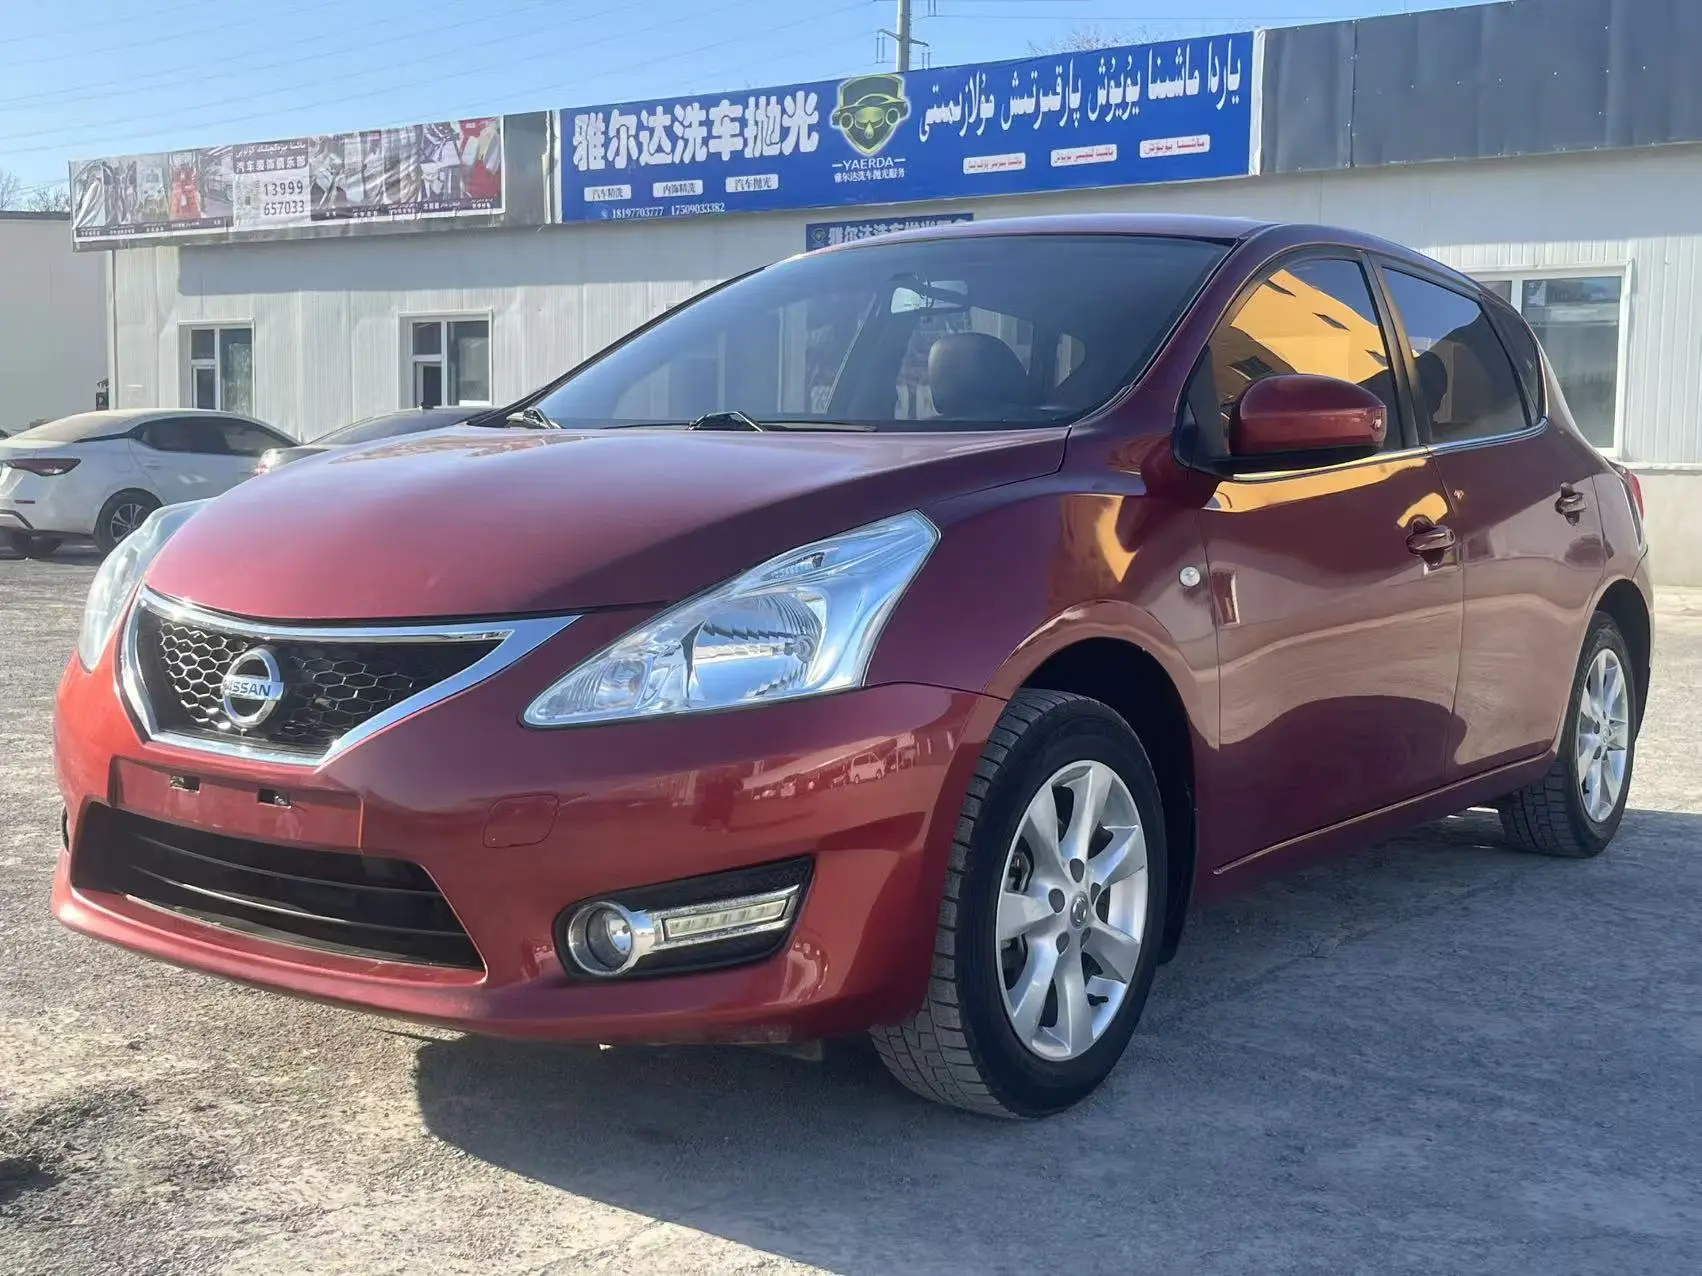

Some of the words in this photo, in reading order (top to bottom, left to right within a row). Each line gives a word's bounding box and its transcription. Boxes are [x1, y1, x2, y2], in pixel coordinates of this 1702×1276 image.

[1148, 44, 1200, 100] ماشىنا
[573, 91, 819, 171] 雅尔达洗车抛光
[842, 157, 894, 171] YAERDA
[263, 180, 303, 197] 13999
[263, 200, 305, 216] 657033
